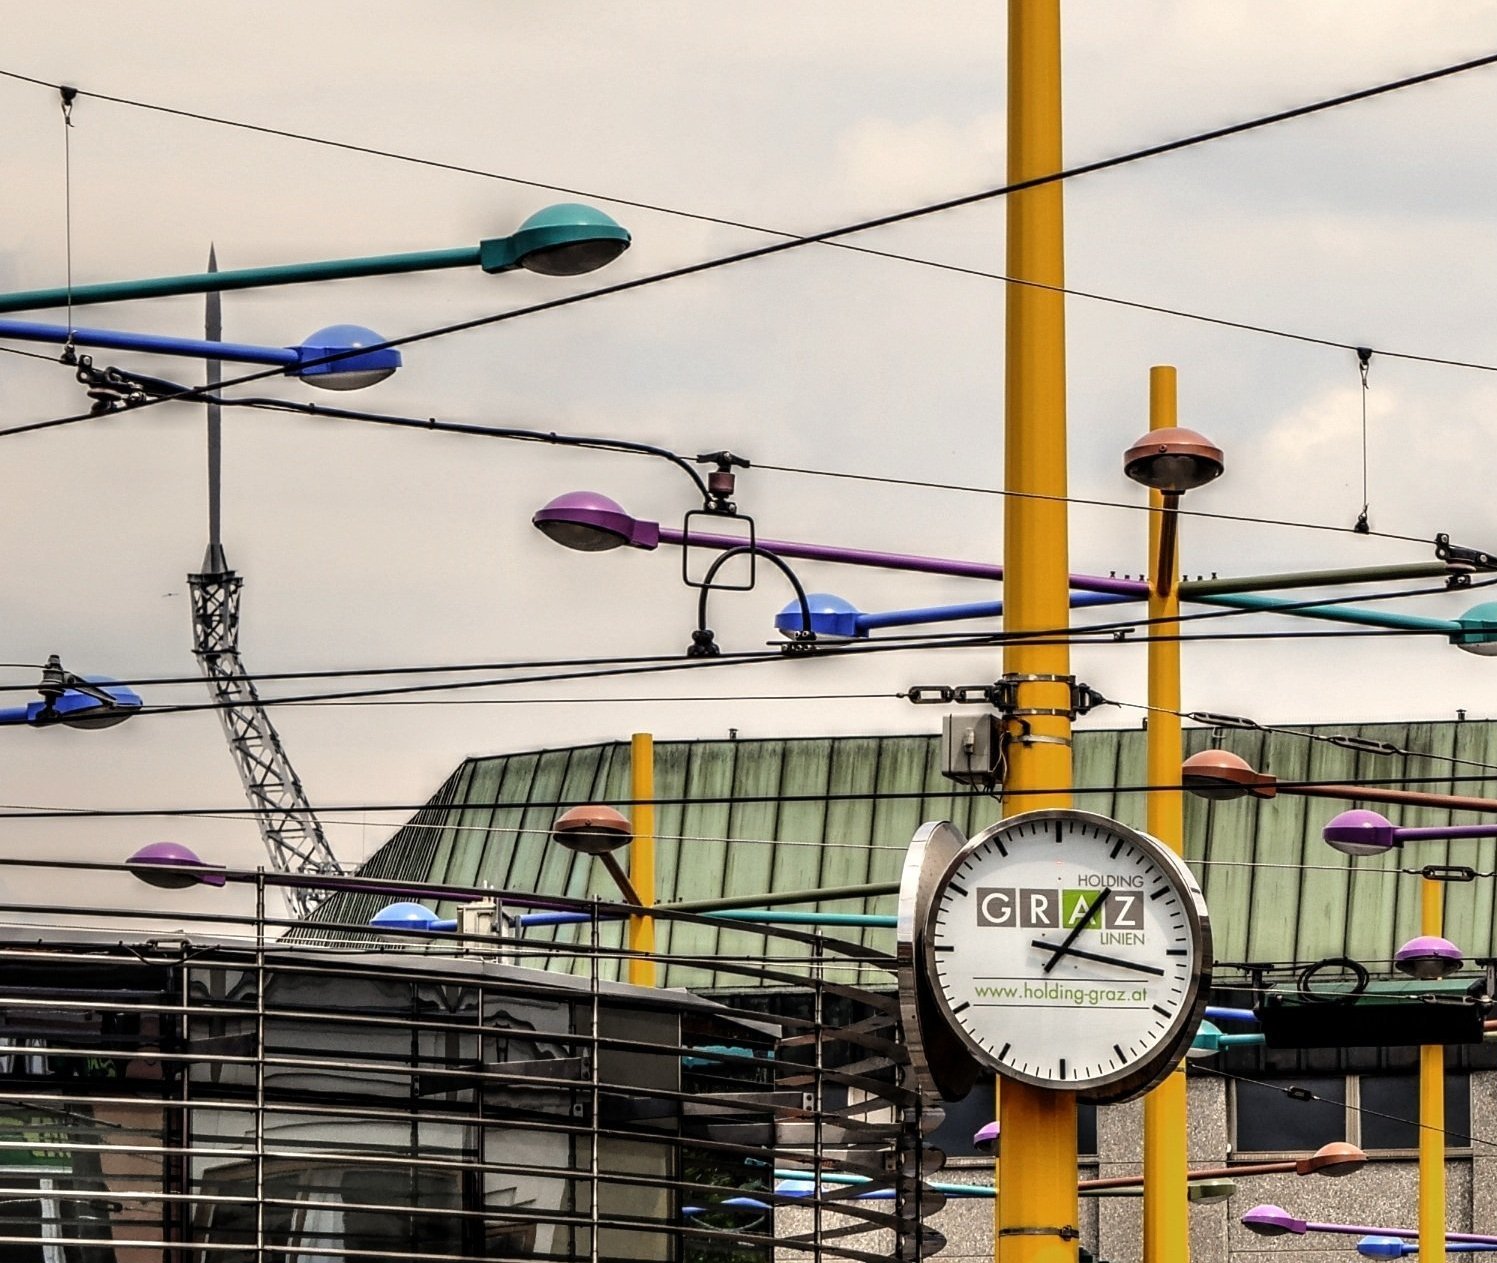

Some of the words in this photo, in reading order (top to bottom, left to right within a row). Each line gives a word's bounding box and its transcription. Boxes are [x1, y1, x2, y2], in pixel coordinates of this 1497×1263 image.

[1078, 874, 1144, 888] HOLDING
[979, 891, 1140, 927] GRAZ
[1100, 932, 1145, 945] LINIEN
[974, 982, 1147, 1005] www.holding-graz.at
